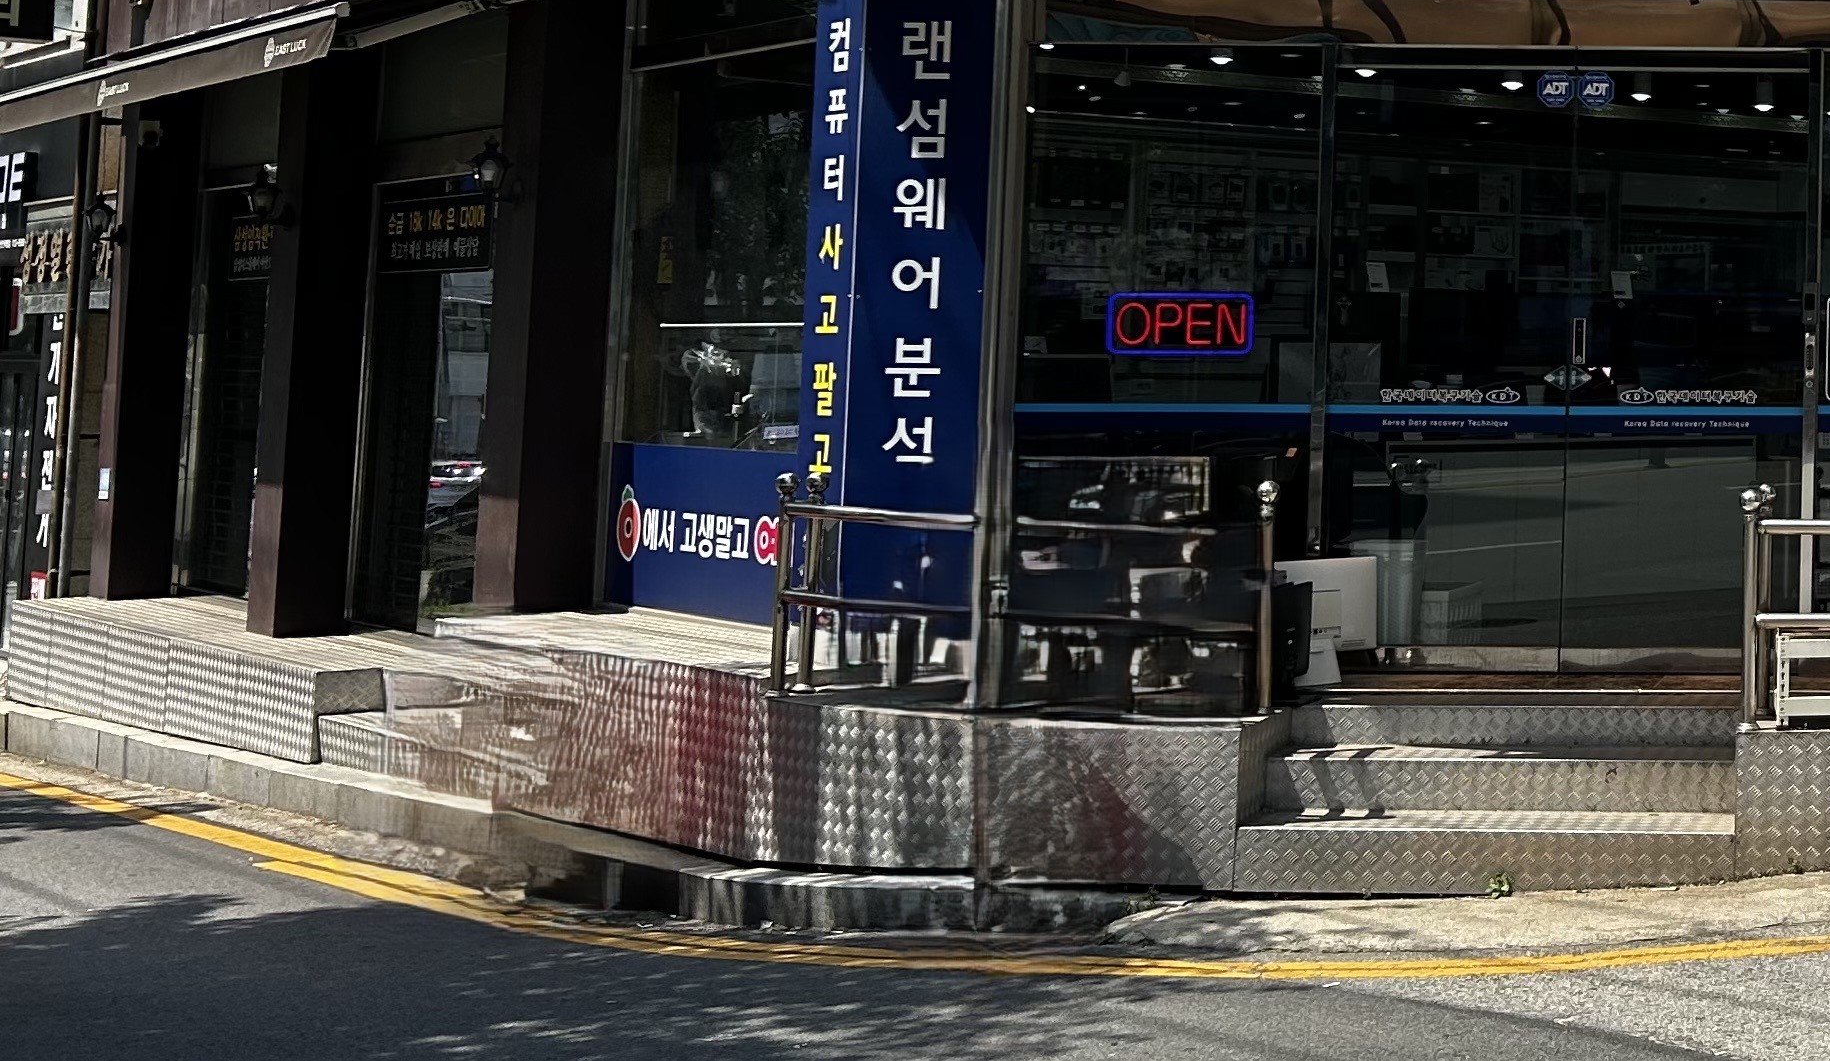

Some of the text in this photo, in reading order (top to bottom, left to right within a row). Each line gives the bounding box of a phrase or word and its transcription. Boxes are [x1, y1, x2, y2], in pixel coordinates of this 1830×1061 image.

[1542, 81, 1570, 95] ADT
[1582, 82, 1610, 96] ADT
[1115, 302, 1248, 346] OPEN
[642, 507, 676, 553] 에서
[680, 511, 750, 560] 고생말고
